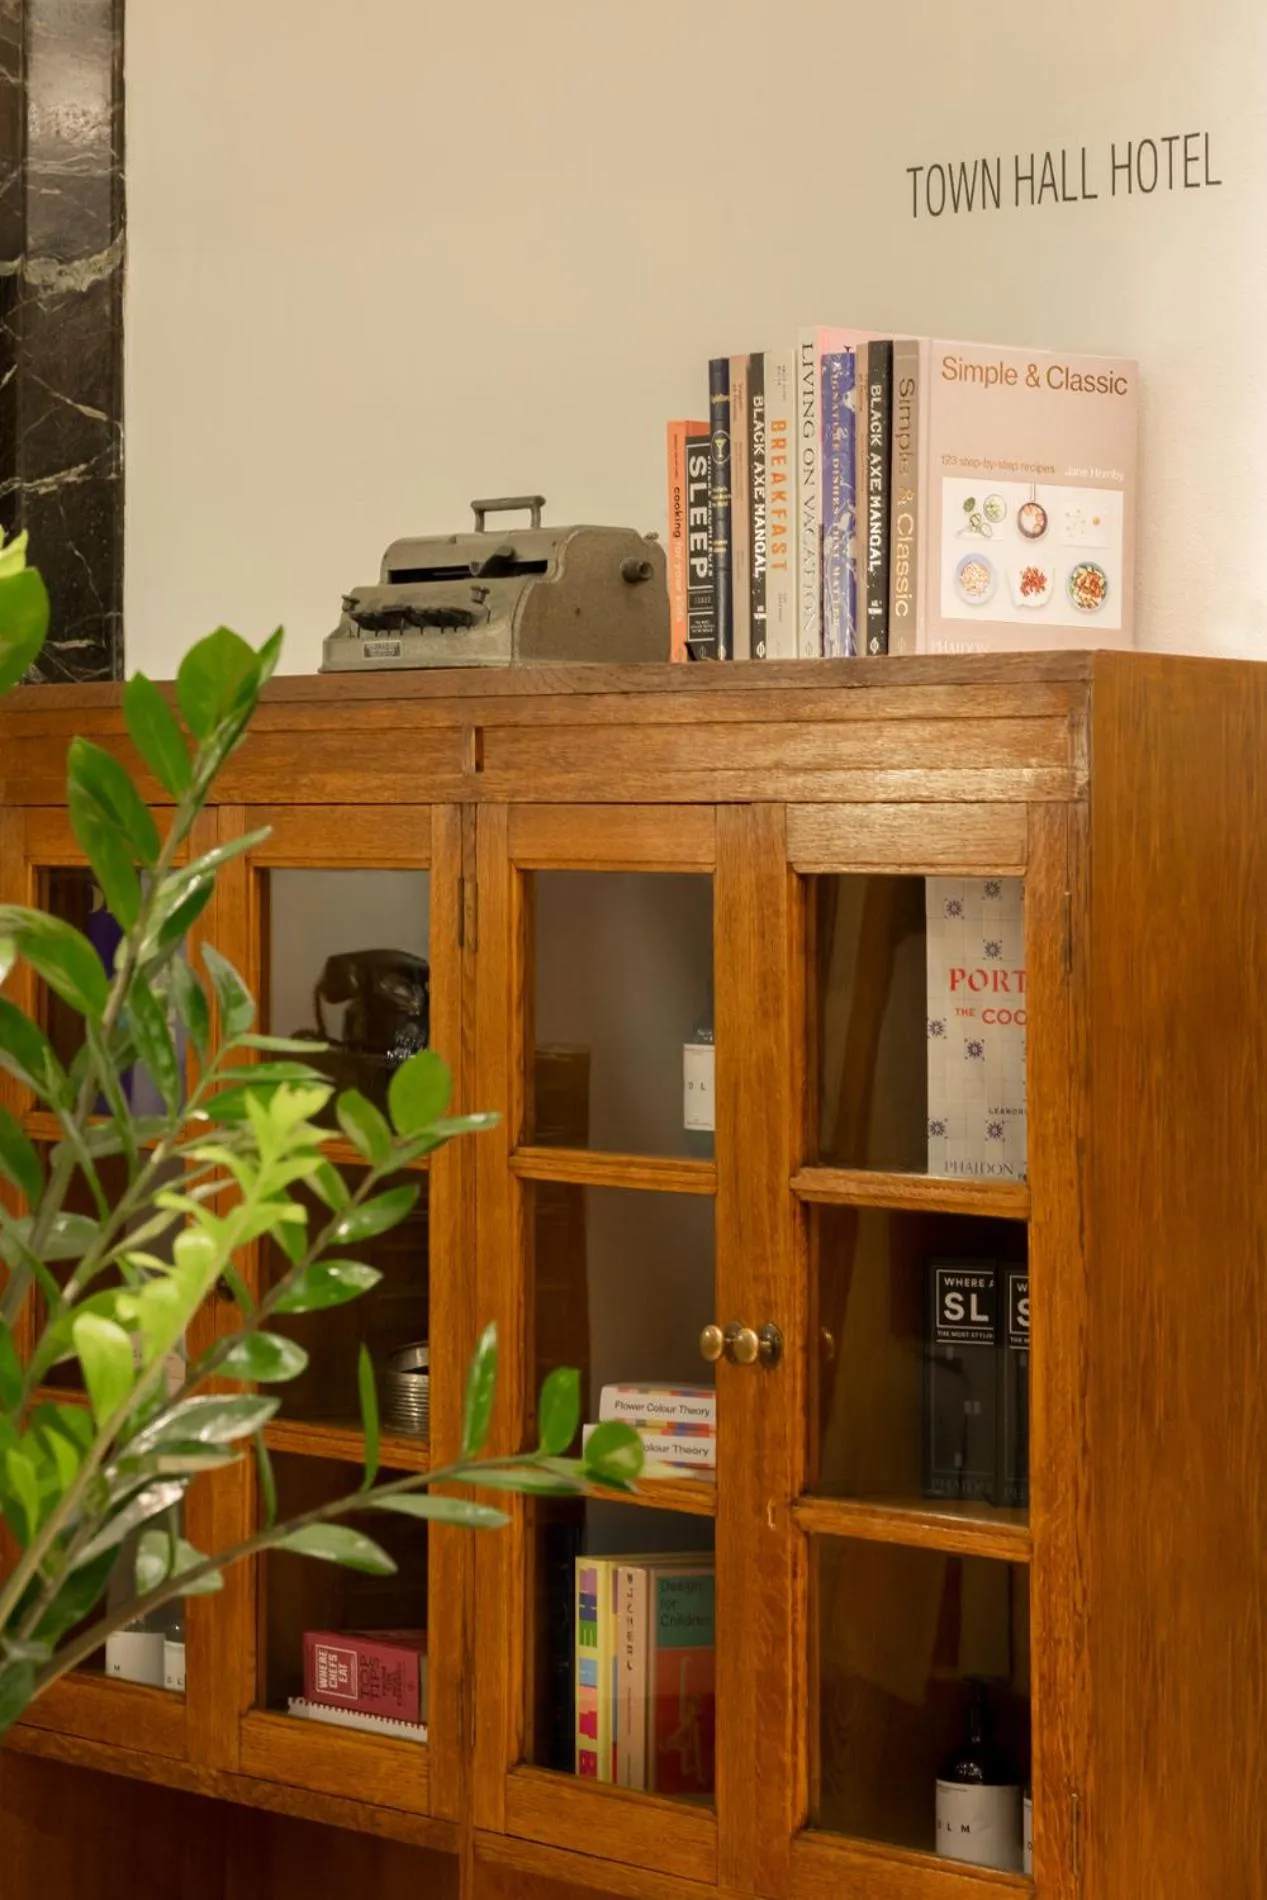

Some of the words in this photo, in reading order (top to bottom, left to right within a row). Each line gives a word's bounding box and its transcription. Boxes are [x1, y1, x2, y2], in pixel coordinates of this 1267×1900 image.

[907, 157, 1000, 218] TOWN
[1015, 147, 1098, 207] HALL
[1111, 132, 1222, 197] HOTEL
[802, 343, 814, 438] LIVING
[942, 357, 1018, 389] Simple
[1025, 363, 1040, 387] &
[1047, 364, 1128, 396] Classic
[753, 396, 765, 455] BLACK
[870, 384, 882, 446] BLACK
[897, 378, 915, 474] Simple
[753, 462, 765, 500] AXE
[803, 448, 814, 485] ON
[870, 453, 882, 490] AXE
[672, 486, 681, 539] cooking
[689, 456, 707, 579] SLEEP
[770, 420, 787, 572] BREAKFAST
[897, 486, 913, 504] &
[753, 503, 766, 576] MANGAL
[869, 495, 881, 571] MANGAL
[803, 495, 815, 630] VACATION
[896, 513, 914, 616] Classic
[948, 968, 1026, 992] PORT
[955, 1007, 976, 1017] THE
[944, 1160, 1014, 1176] PHAIDON
[944, 1277, 985, 1288] WHERE
[614, 1400, 645, 1411] Flower
[646, 1403, 677, 1414] Colour
[678, 1405, 711, 1417] Theory
[643, 1441, 670, 1453] olour
[673, 1445, 710, 1457] Theory
[338, 1662, 348, 1684] EAT
